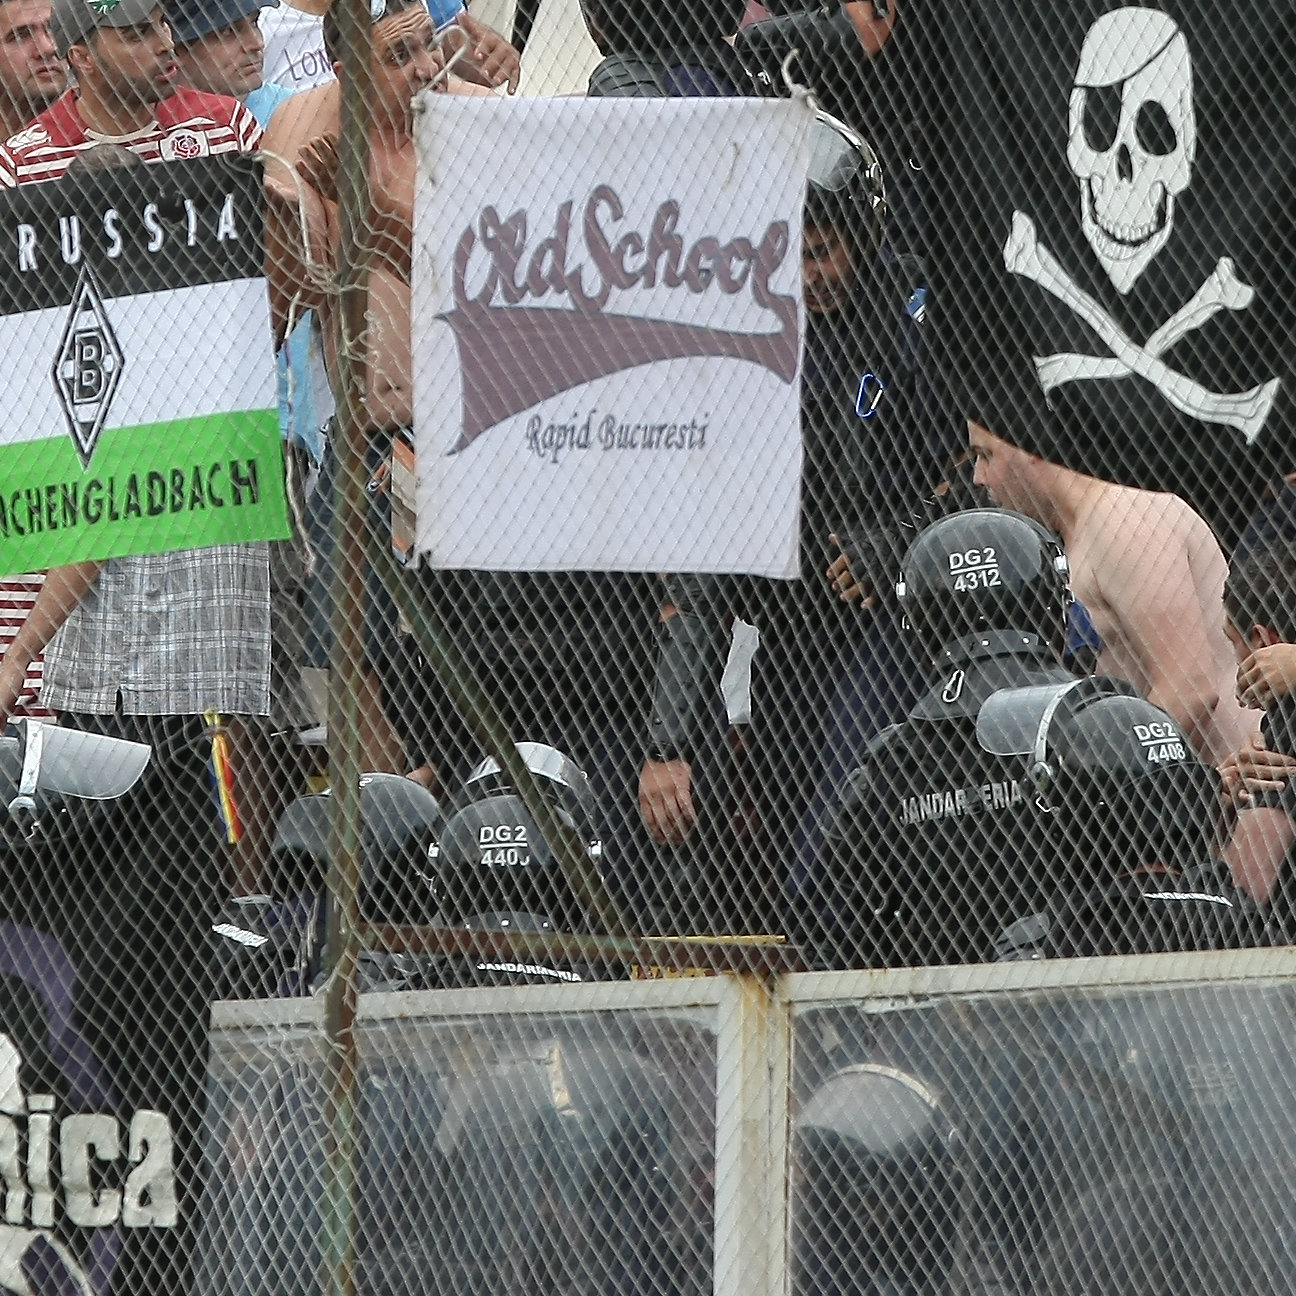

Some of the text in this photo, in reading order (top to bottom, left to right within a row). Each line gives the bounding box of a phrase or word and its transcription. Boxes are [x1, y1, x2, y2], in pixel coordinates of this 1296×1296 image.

[525, 409, 711, 463] Rapid Bucuresti
[954, 567, 1002, 592] 4312
[1133, 721, 1177, 744] DG2
[1147, 741, 1186, 765] 4408
[898, 779, 1023, 826] JANDARERIA
